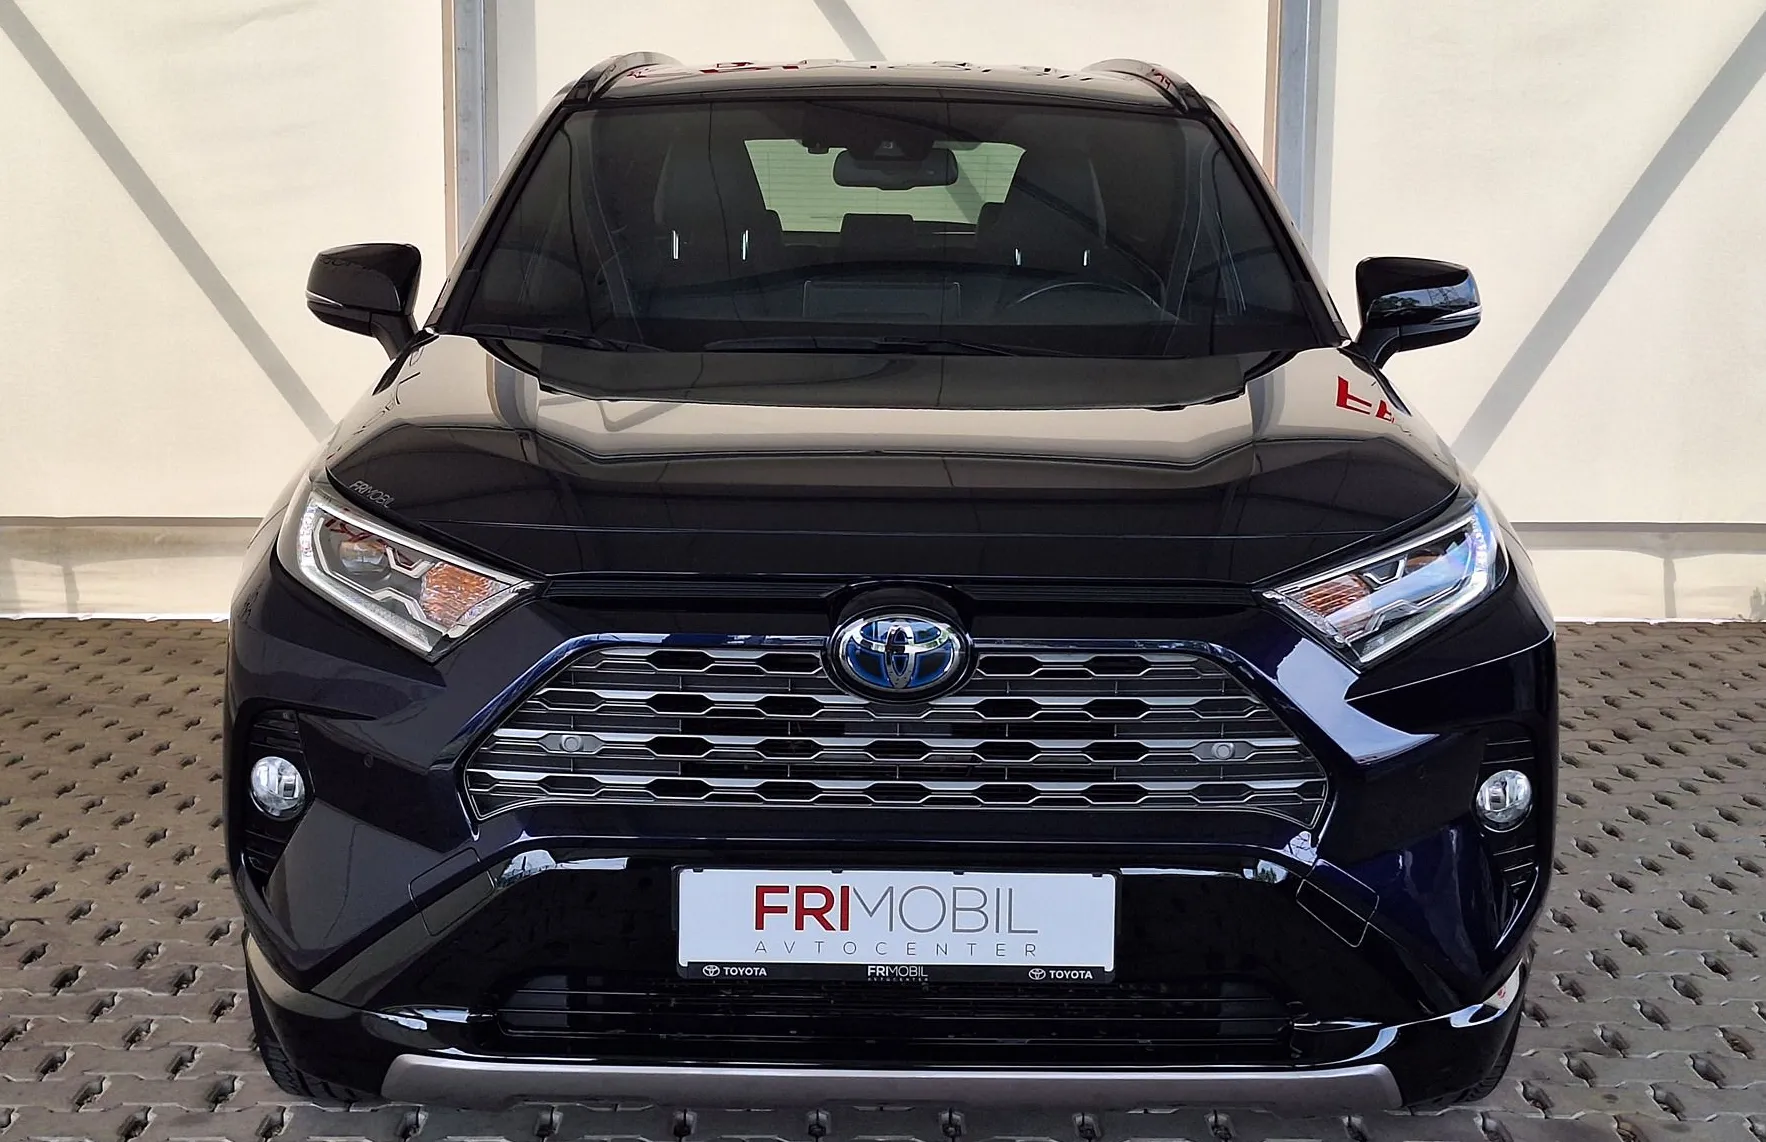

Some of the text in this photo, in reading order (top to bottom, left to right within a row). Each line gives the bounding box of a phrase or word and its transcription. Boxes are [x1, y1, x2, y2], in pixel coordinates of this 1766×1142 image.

[349, 480, 395, 508] FRIMOBIL
[755, 885, 1039, 934] FRIMOBIL
[754, 940, 1037, 958] AVTOCENTER
[723, 966, 767, 977] TOYOTA
[867, 965, 928, 977] FRIMOBIL
[1049, 970, 1093, 980] TOYOTA
